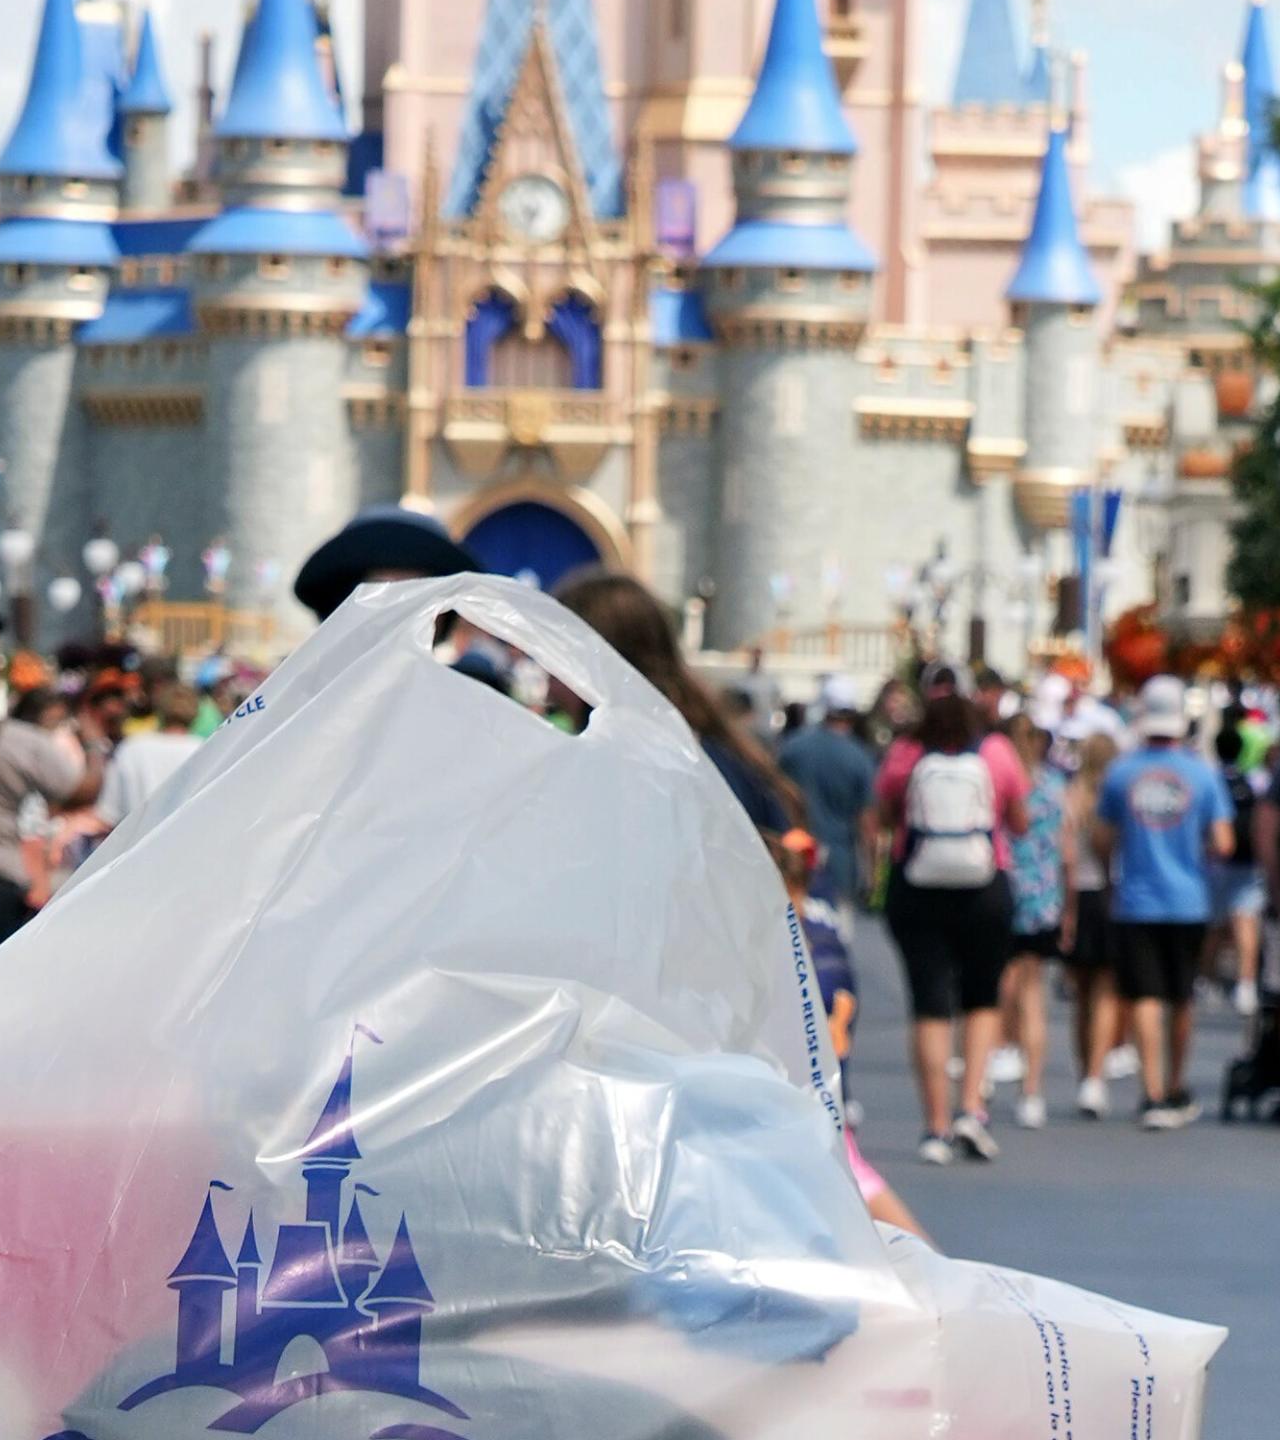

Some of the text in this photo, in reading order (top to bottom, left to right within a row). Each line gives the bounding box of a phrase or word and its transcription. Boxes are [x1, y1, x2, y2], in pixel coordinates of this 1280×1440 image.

[801, 1001, 819, 1055] REUSE
[1045, 1370, 1056, 1406] con
[1145, 1375, 1155, 1396] To
[1050, 1412, 1060, 1431] la
[1063, 1399, 1072, 1424] no
